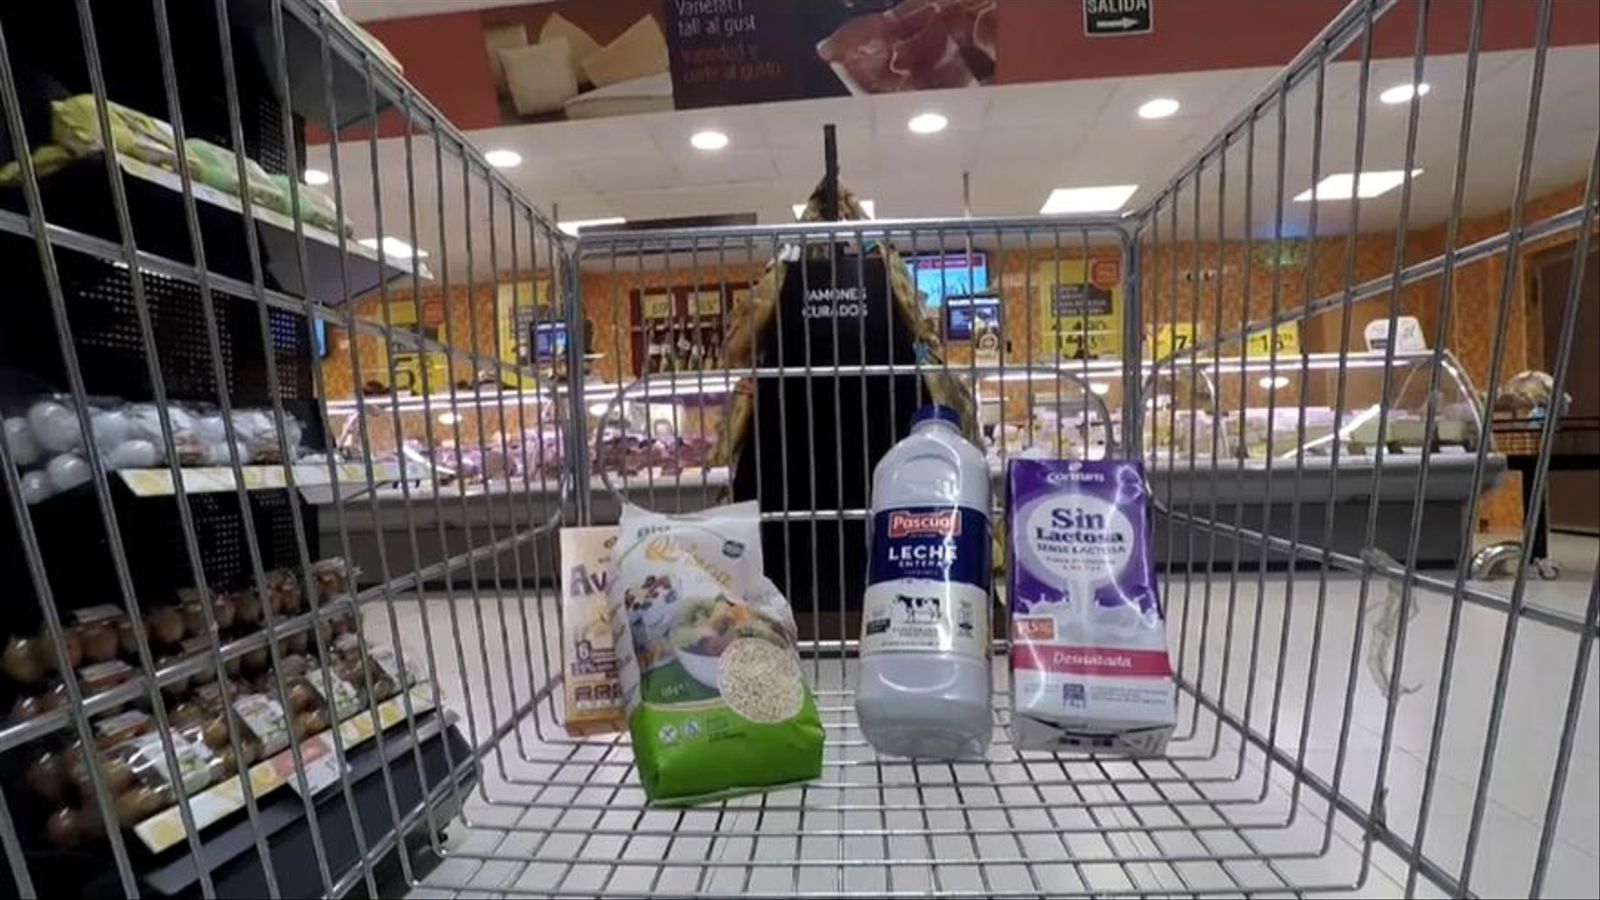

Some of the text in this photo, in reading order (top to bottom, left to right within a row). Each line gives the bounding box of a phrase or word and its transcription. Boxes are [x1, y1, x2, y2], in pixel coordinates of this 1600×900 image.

[1088, 0, 1147, 14] SALIDA
[706, 16, 720, 34] al
[724, 15, 755, 37] gust
[803, 286, 867, 302] AMONES
[801, 303, 868, 319] CURADOS
[893, 514, 956, 530] Pascual
[1052, 508, 1104, 529] Sin
[1035, 528, 1124, 544] Lactosa
[888, 544, 958, 561] LECHE
[1052, 651, 1132, 668] Desnatada
